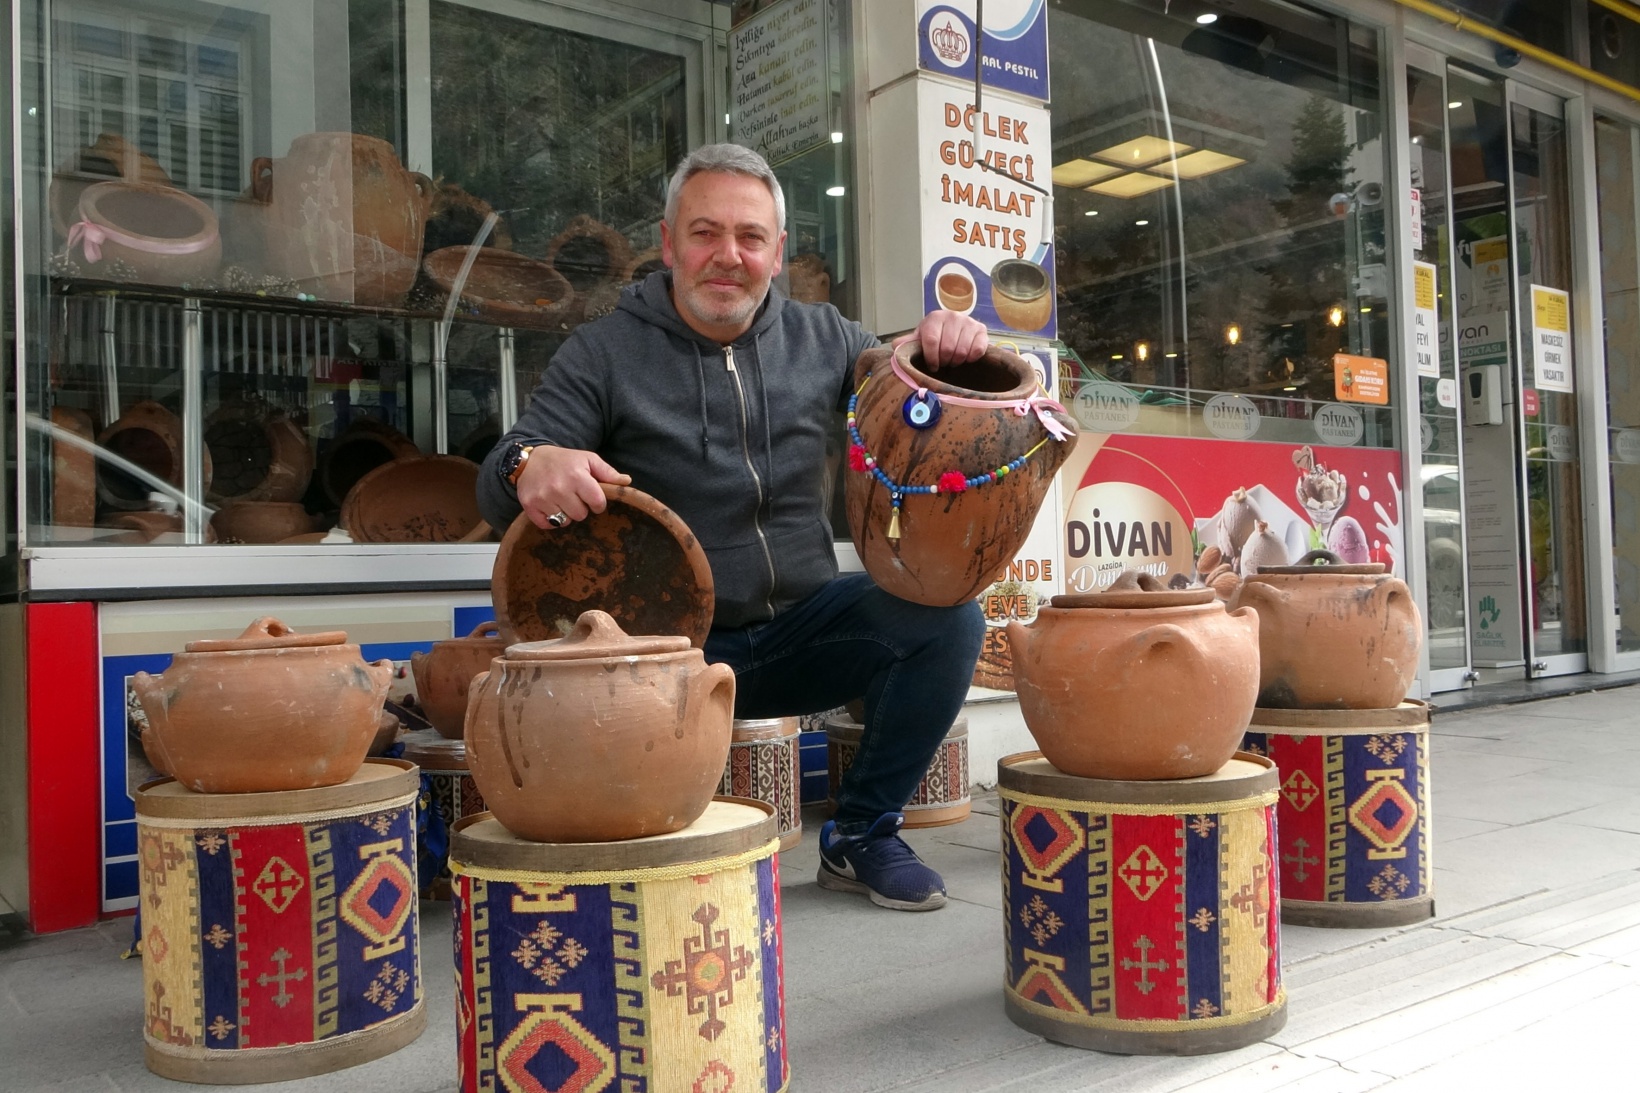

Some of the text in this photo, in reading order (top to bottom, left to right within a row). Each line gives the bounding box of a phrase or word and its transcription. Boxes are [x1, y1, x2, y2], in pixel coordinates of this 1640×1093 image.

[735, 26, 764, 52] İyiliğe
[767, 9, 790, 31] niyet
[982, 55, 1002, 69] RAL
[941, 174, 1035, 217] İMALAT
[953, 218, 1026, 258] SATIŞ
[1541, 333, 1563, 348] MASKESİZ
[1417, 352, 1431, 366] ALIM
[1543, 368, 1564, 382] YASAKTIR
[1081, 391, 1129, 411] DİVAN
[1212, 402, 1251, 421] DİVAN
[1321, 410, 1356, 429] DİVAN
[1067, 507, 1172, 558] DİVAN
[1098, 560, 1123, 572] LAZGİDA
[987, 595, 1028, 618] EVE
